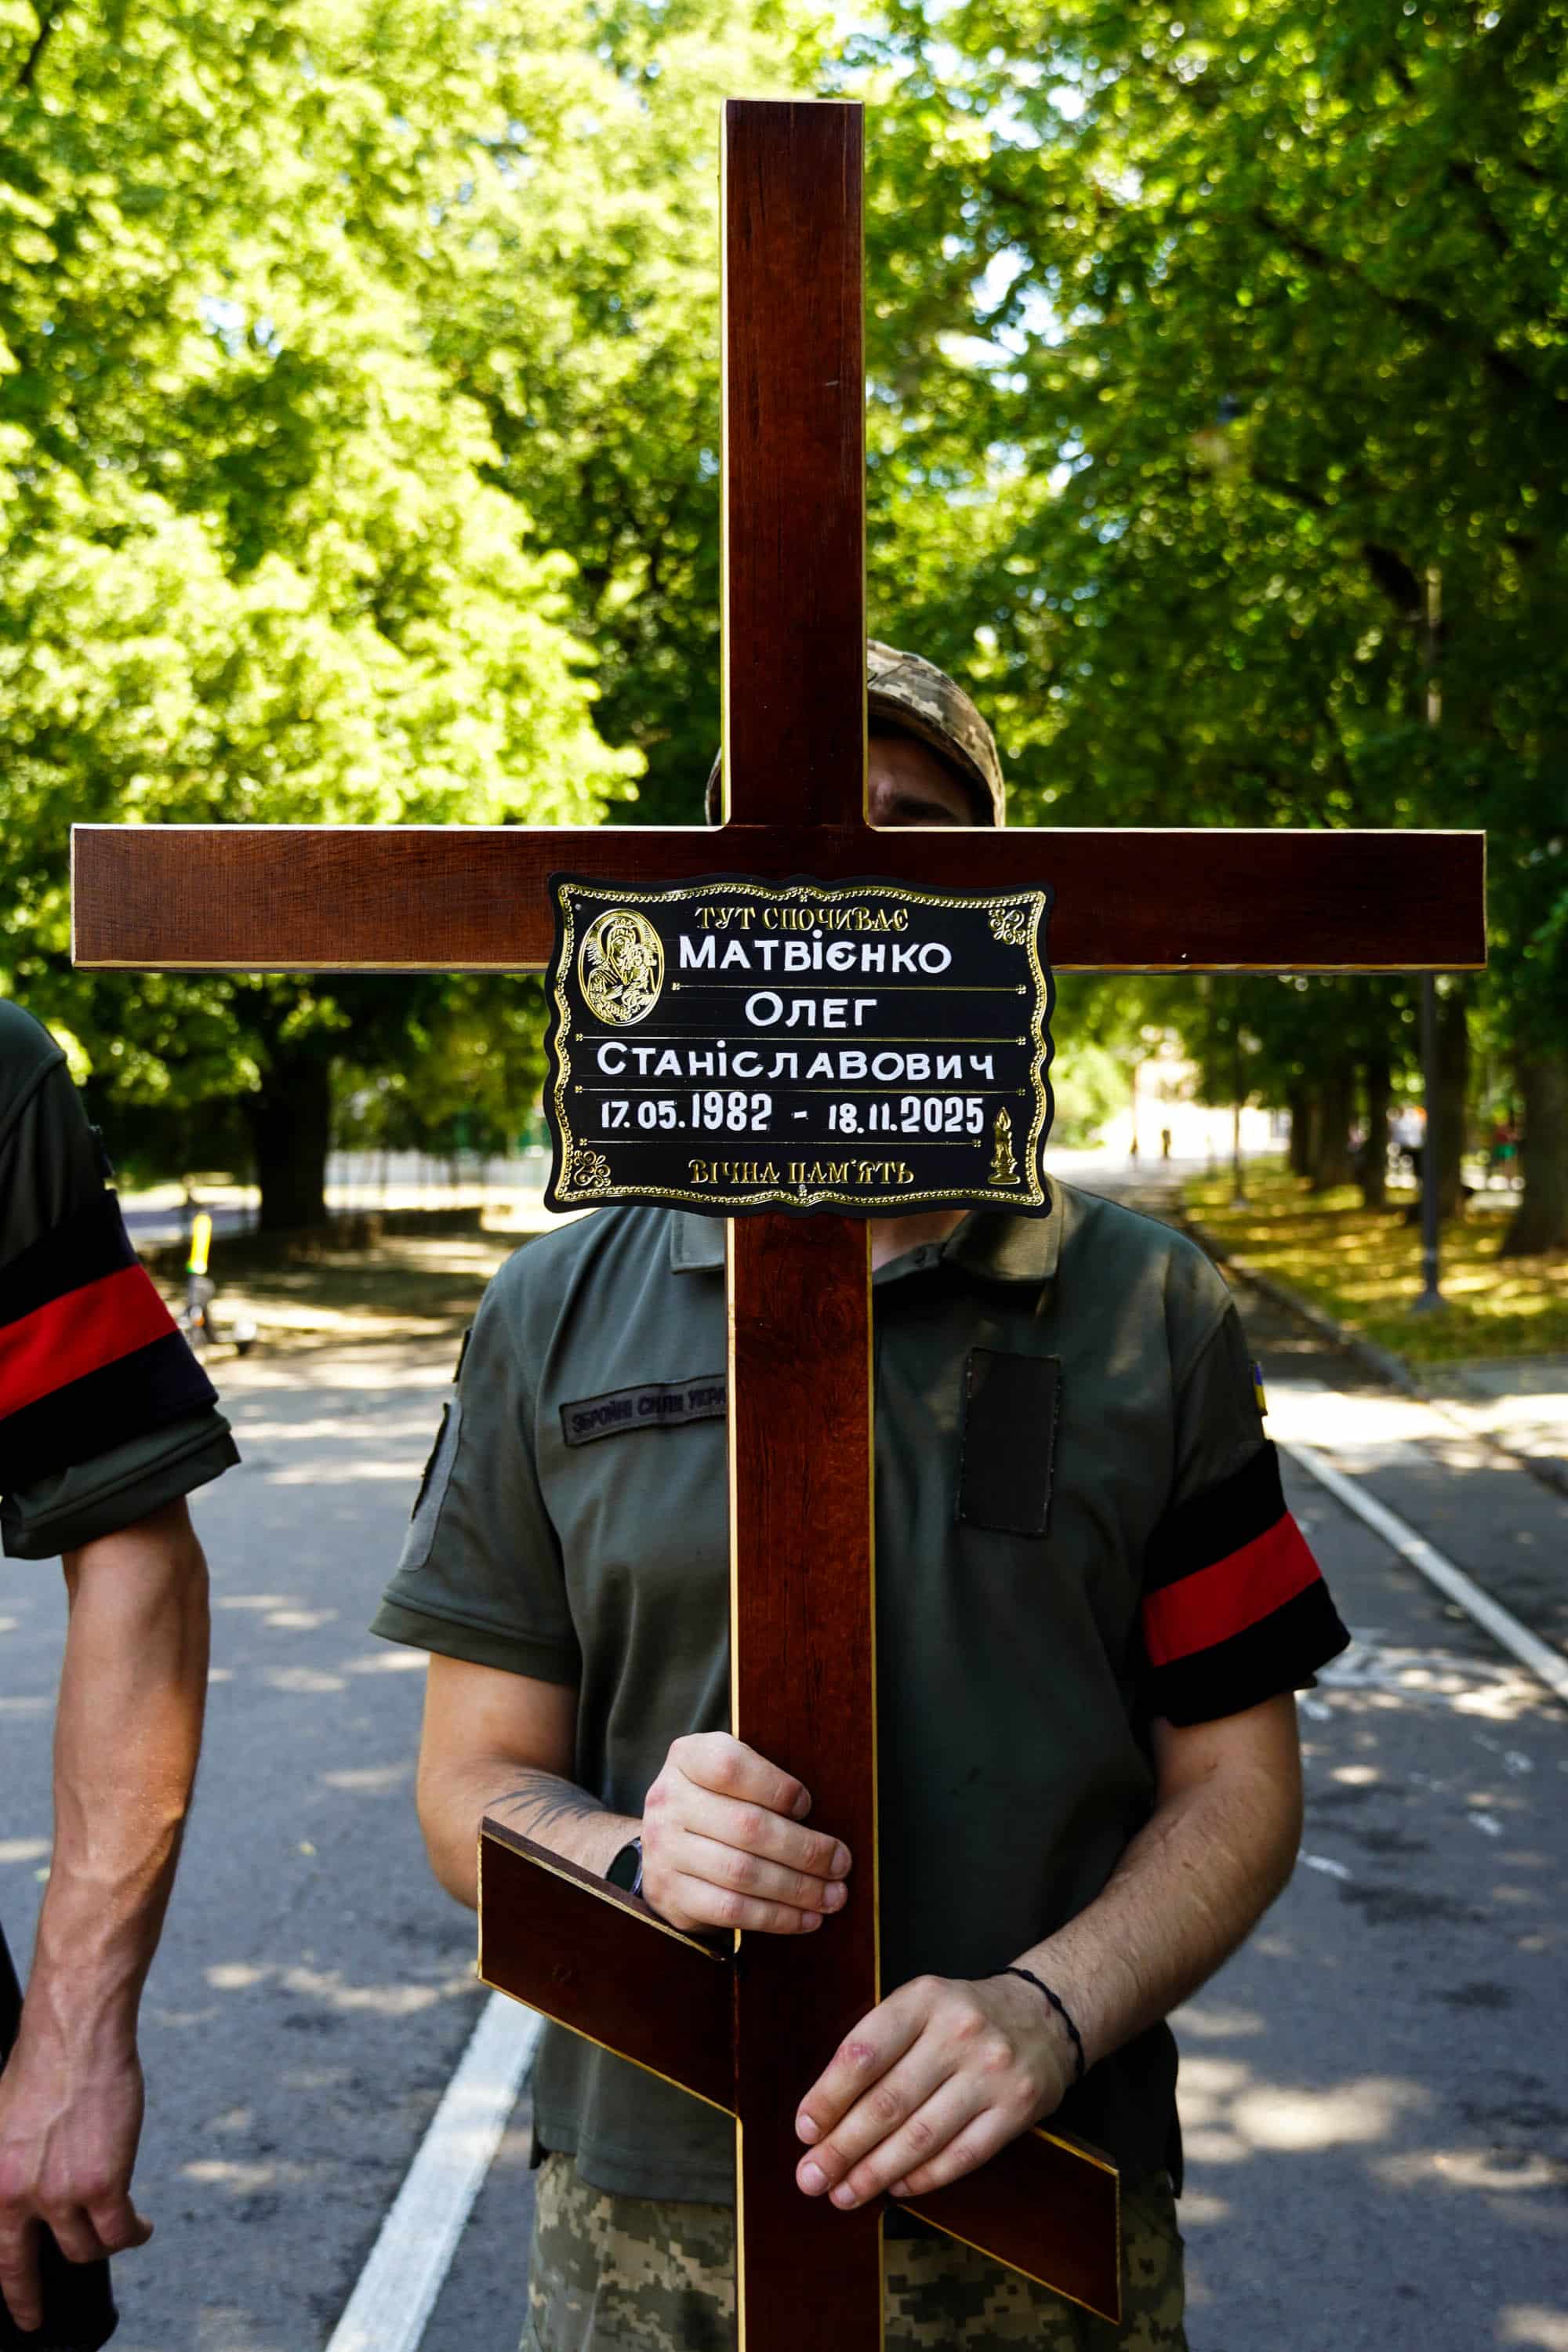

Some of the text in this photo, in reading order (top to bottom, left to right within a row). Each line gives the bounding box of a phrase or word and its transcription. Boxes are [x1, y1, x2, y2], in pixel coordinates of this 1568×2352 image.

[695, 906, 909, 931] ТУТ СПОЧИВАЄ
[745, 991, 877, 1028] ОЛЕГ
[601, 1091, 772, 1131] 17.05.1982
[828, 1096, 984, 1134] 18.11.2025
[688, 1160, 781, 1184] ВІЧНА
